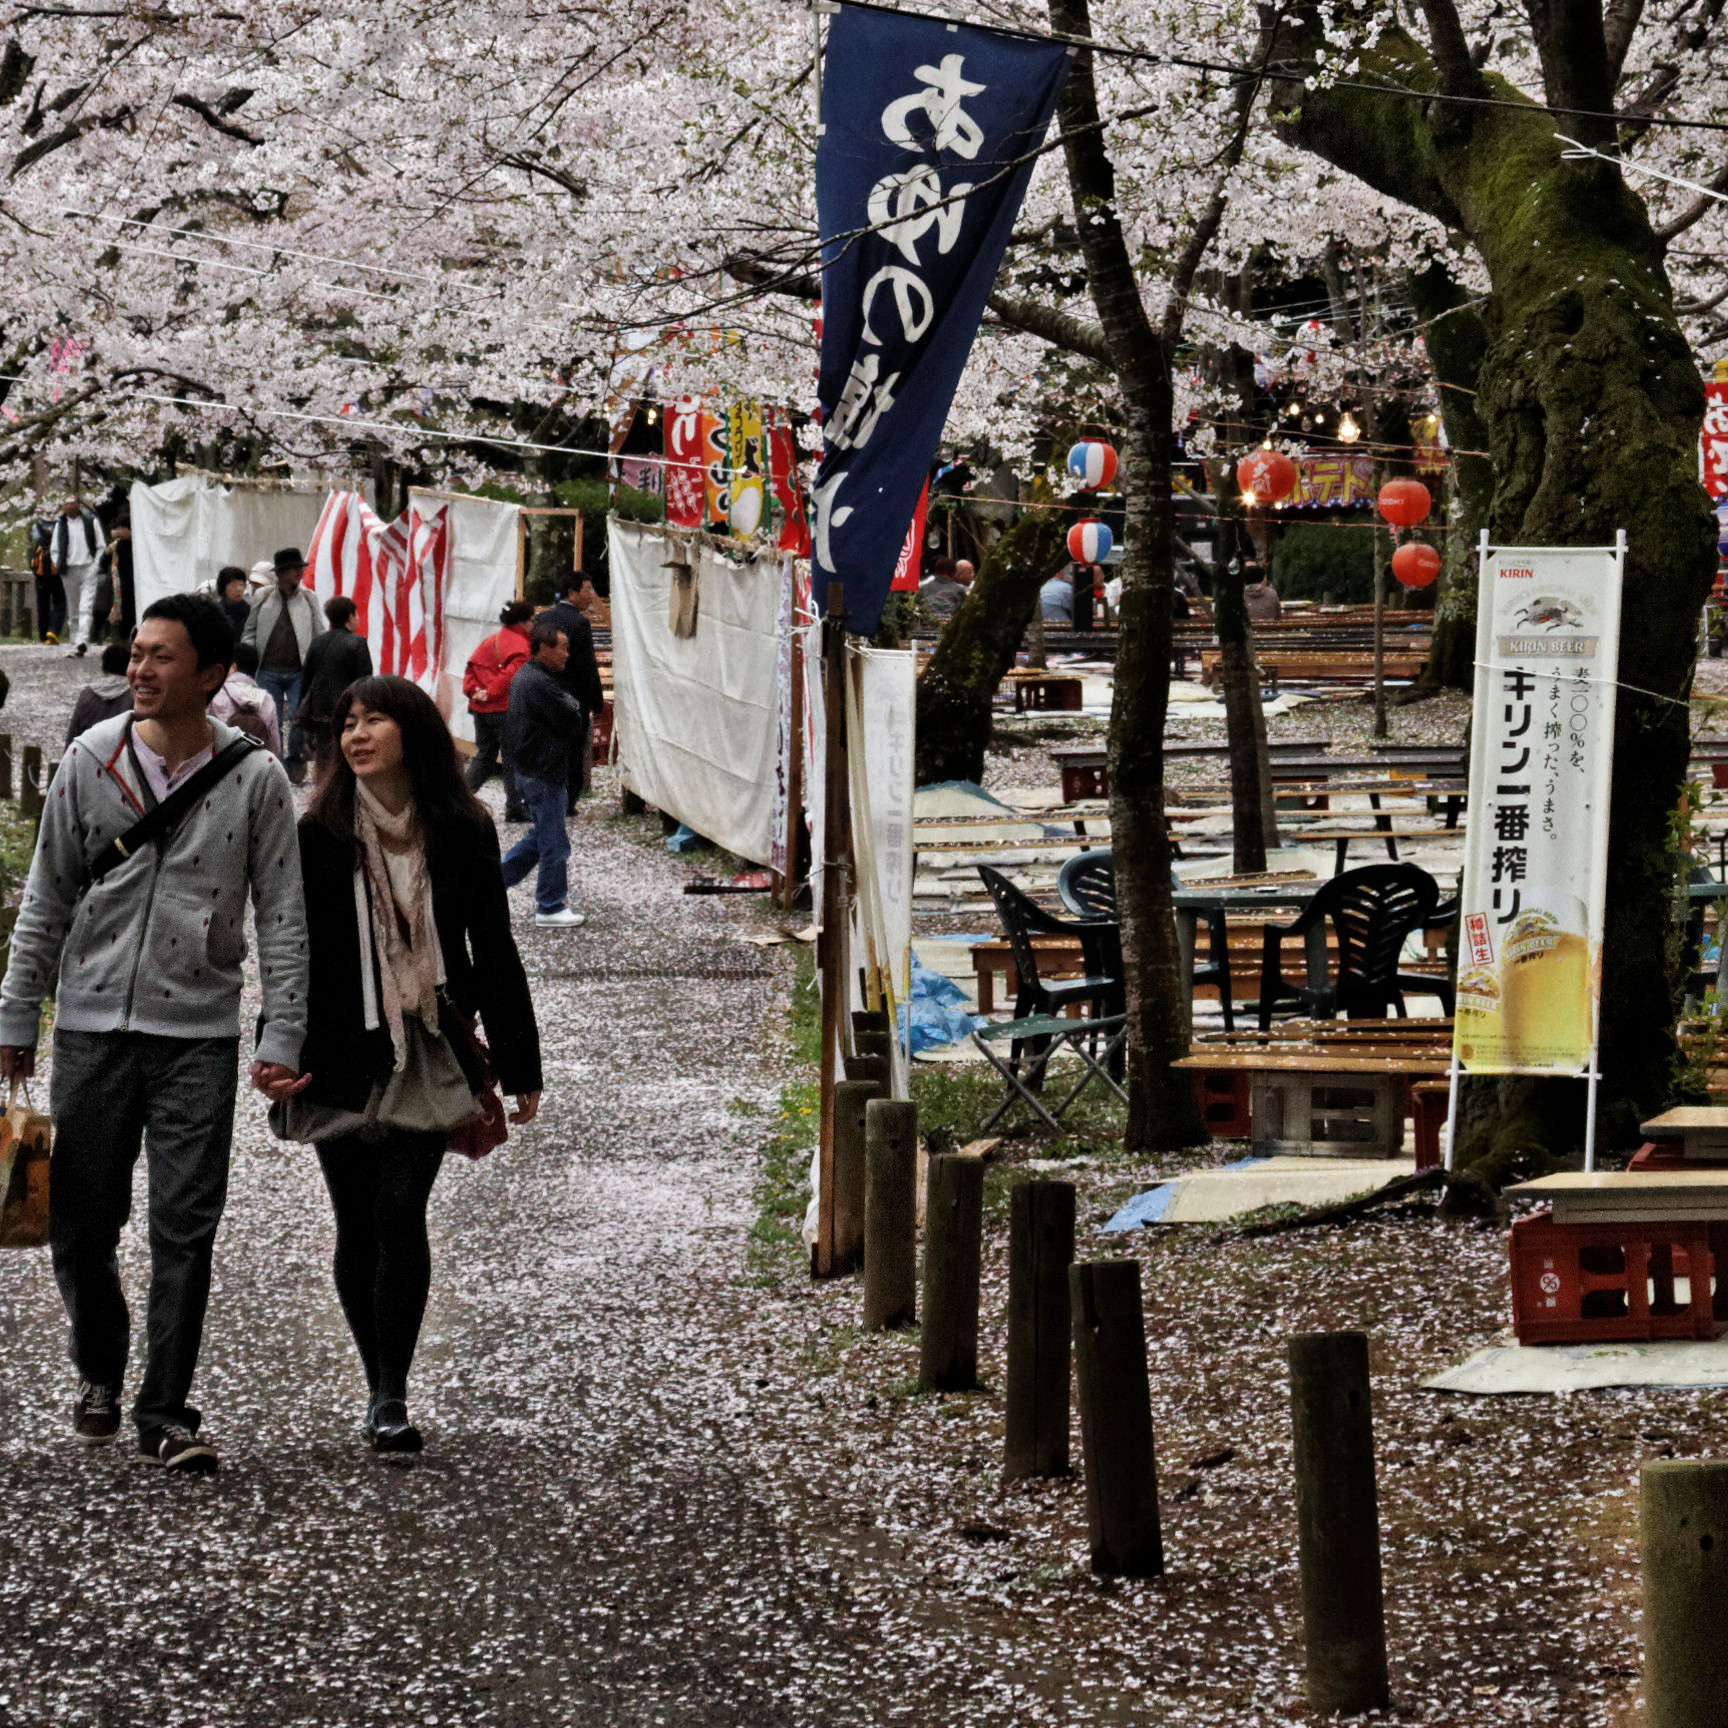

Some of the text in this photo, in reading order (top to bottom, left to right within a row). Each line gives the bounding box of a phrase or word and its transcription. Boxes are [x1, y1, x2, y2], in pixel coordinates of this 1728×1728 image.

[1499, 568, 1534, 579] KIRIN
[1510, 640, 1585, 654] KIRIN BEER
[1492, 666, 1536, 925] キリン一番搾り
[1470, 917, 1491, 962] 樽詰生
